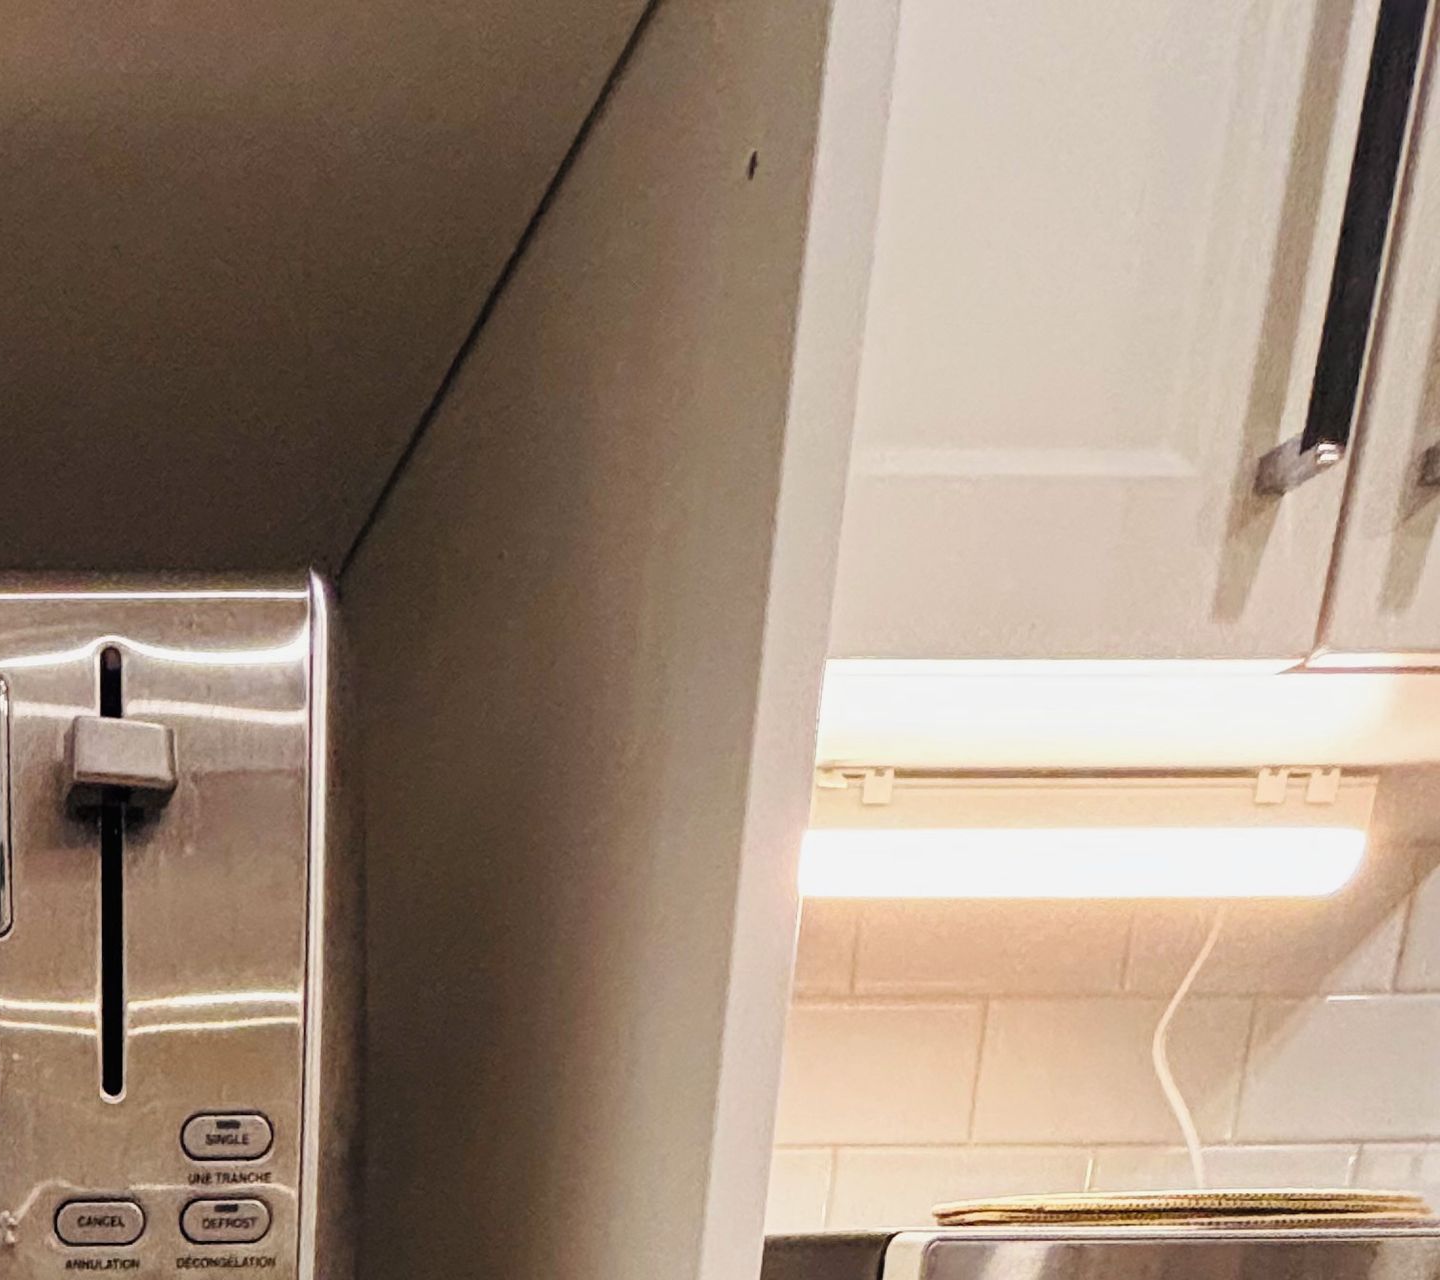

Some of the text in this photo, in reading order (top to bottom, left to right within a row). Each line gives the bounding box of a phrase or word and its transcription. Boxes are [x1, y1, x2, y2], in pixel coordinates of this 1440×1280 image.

[205, 1133, 249, 1146] SINGLE
[188, 1172, 272, 1185] UNE TRANCHE
[77, 1215, 125, 1228] CANCEL
[202, 1217, 258, 1230] DEFROST
[65, 1258, 140, 1270] ANNULATION
